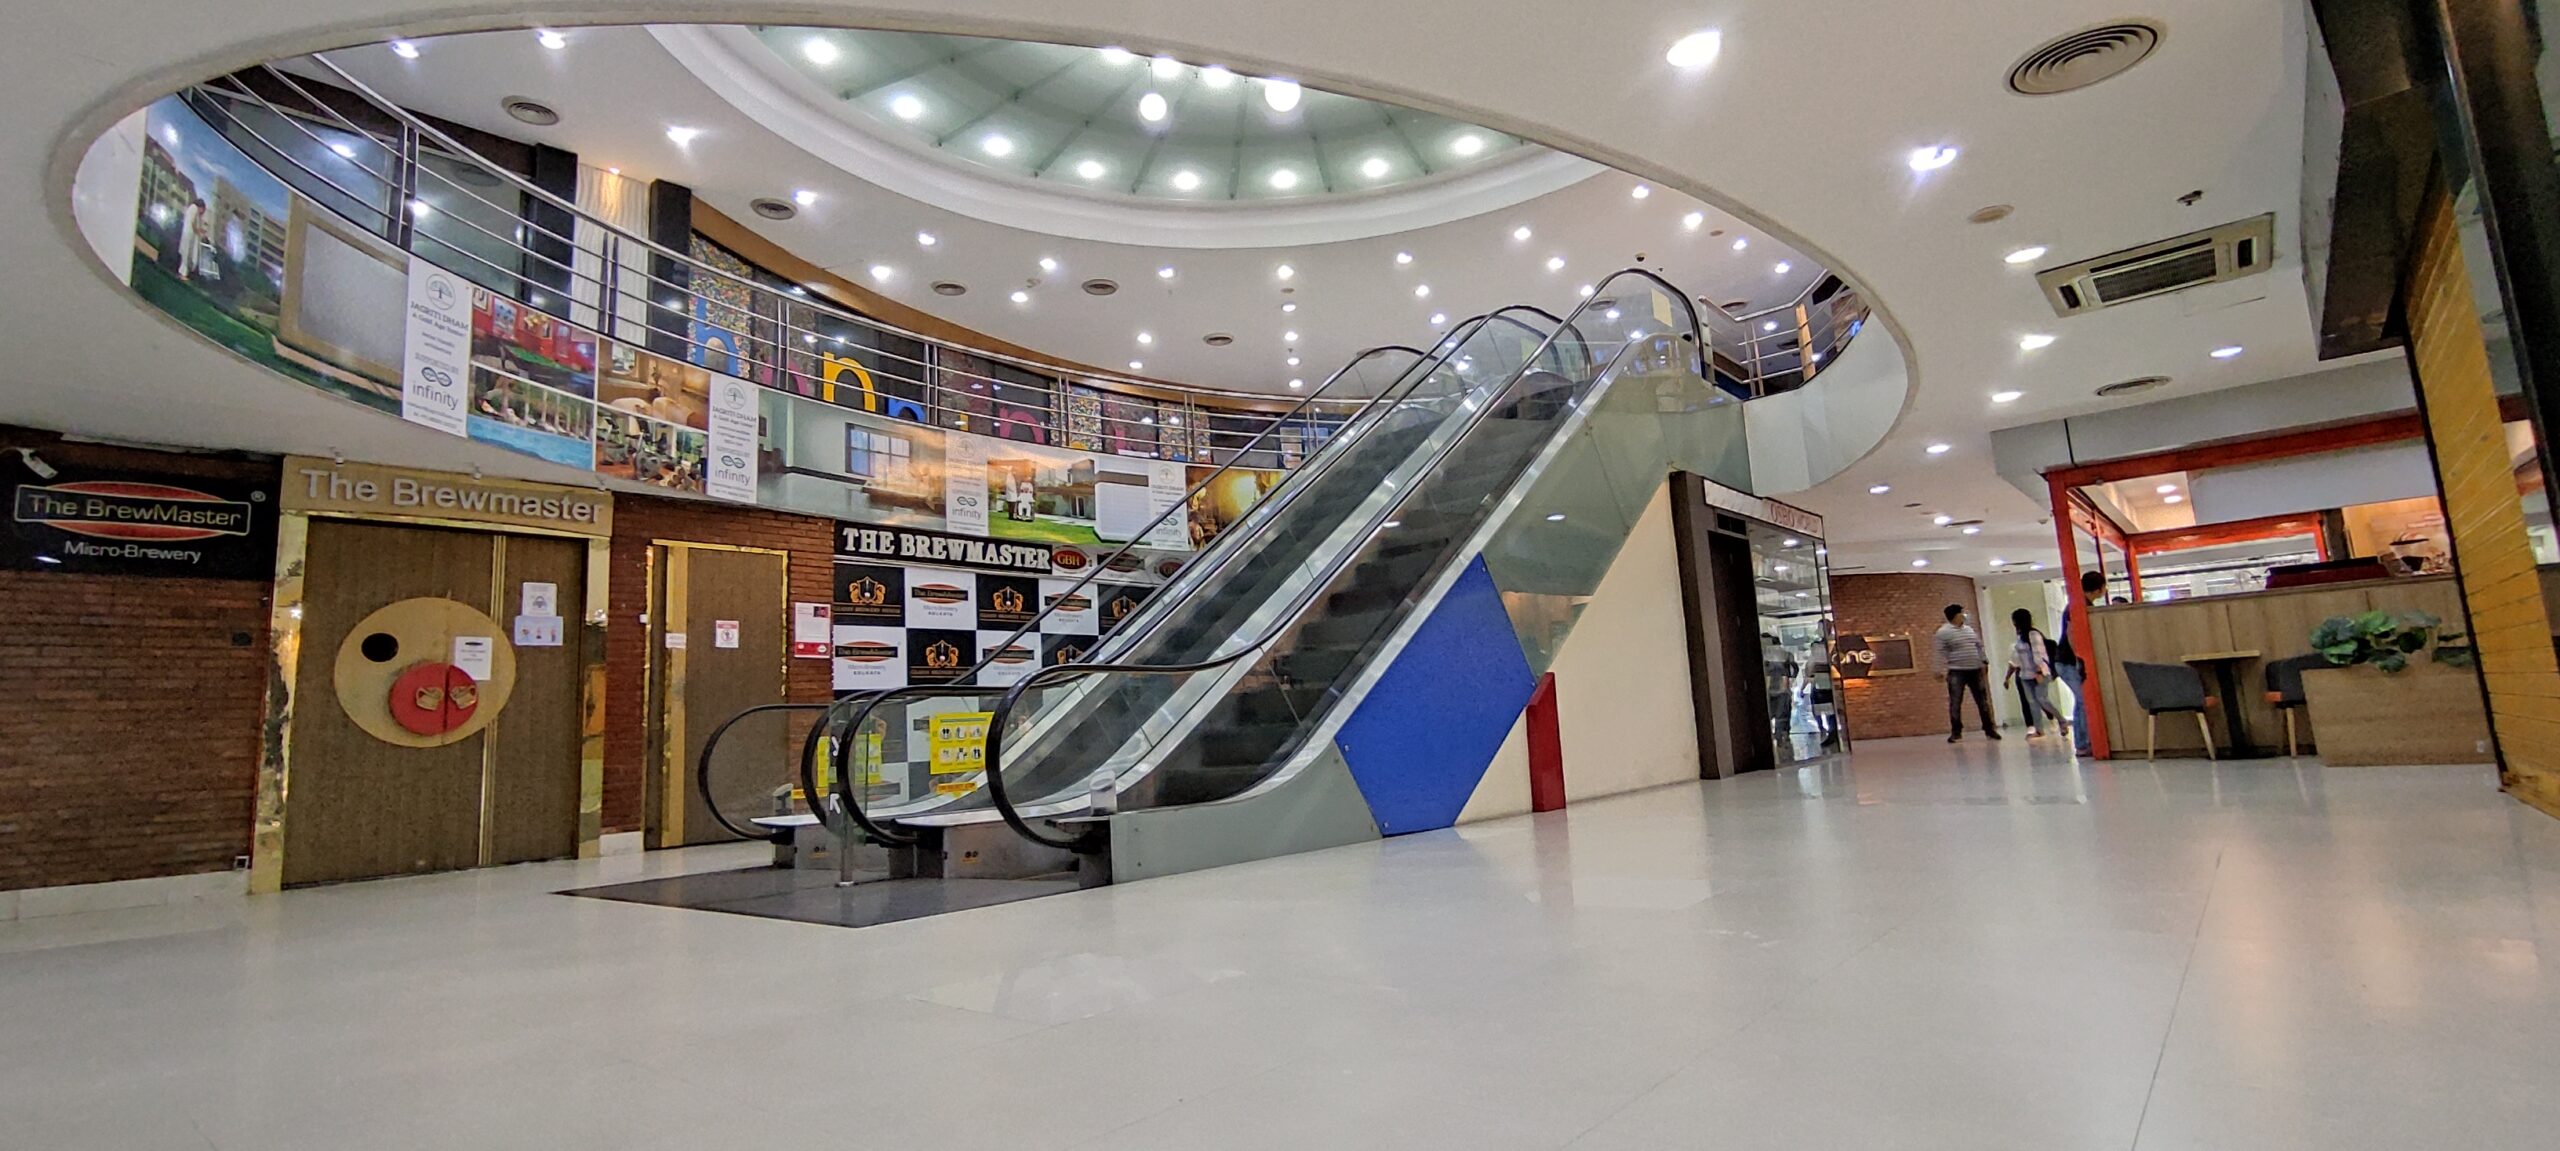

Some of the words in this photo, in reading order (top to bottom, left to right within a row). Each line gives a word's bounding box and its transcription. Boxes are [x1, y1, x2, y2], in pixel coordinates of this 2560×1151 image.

[412, 381, 459, 411] infinity
[714, 466, 751, 487] infinity
[300, 468, 379, 502] The
[393, 477, 605, 524] Brewmaster
[28, 493, 79, 516] The
[86, 499, 242, 527] BrewMaster
[951, 507, 982, 521] infinity
[64, 540, 202, 564] Micro-Brewery
[842, 527, 895, 555] THE
[899, 532, 1052, 570] BREWMASTER
[1056, 554, 1081, 566] GBH
